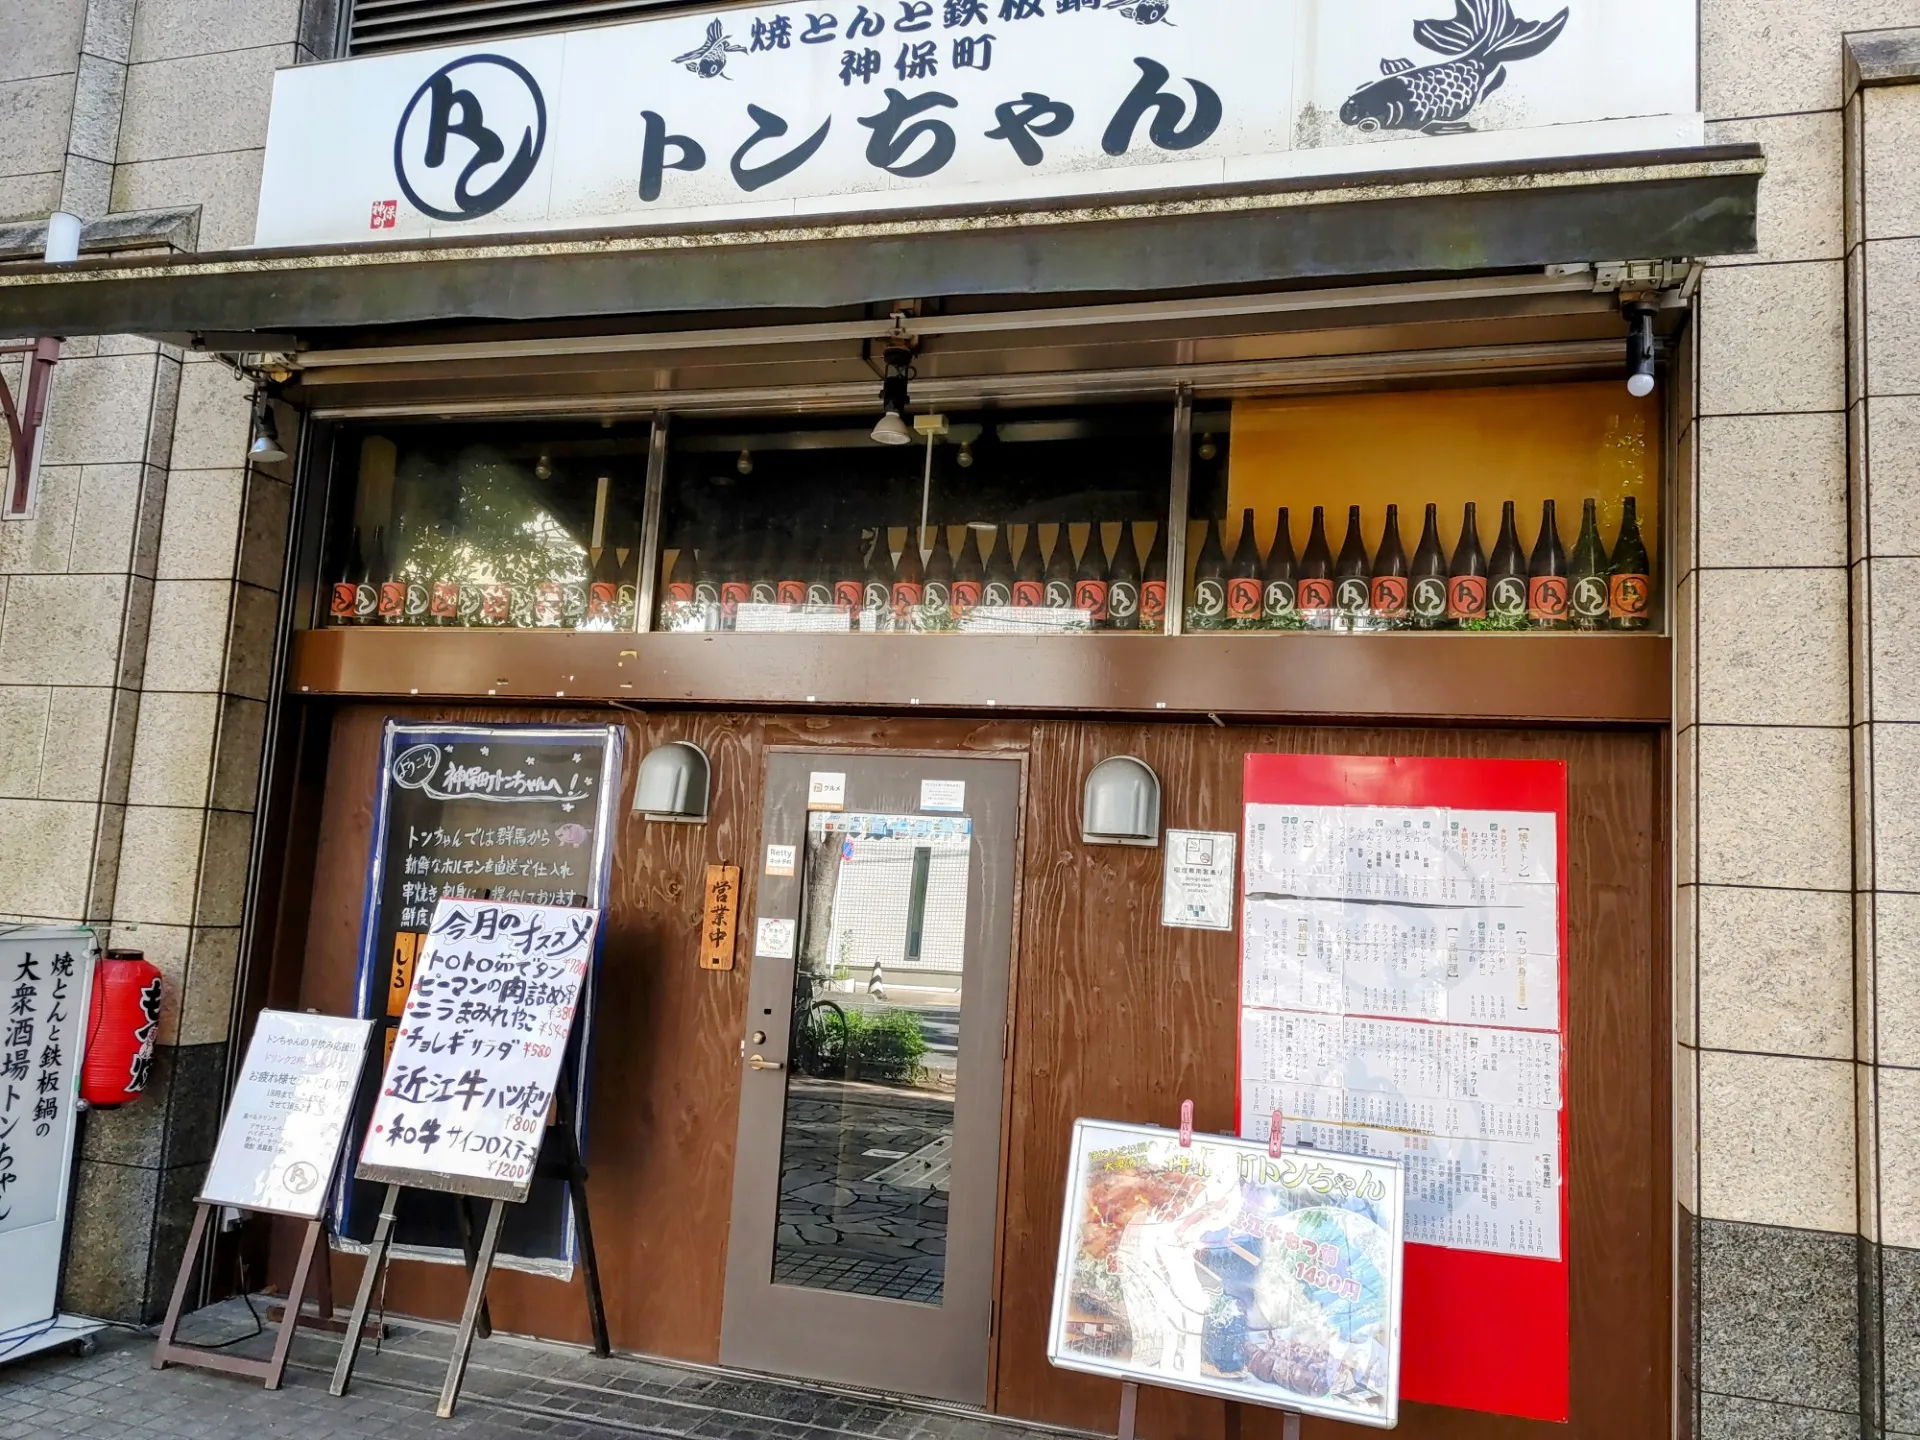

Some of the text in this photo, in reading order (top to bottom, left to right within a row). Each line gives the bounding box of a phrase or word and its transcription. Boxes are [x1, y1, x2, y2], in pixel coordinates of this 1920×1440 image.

[838, 34, 997, 86] 神保町
[638, 56, 1225, 203] トンちゃん
[408, 824, 550, 849] トンちゃんでは群馬から
[404, 854, 575, 878] 新鮮なホルモンを直送で仕入れ
[770, 849, 793, 858] Retty
[400, 907, 434, 927] 鮮度
[709, 881, 732, 949] 営業中
[432, 908, 593, 956] 今月のオススメ
[32, 952, 74, 1138] 焼とんと鉄板鍋の
[523, 1042, 552, 1058] ¥580
[503, 1114, 537, 1134] ¥800
[486, 1159, 524, 1178] ¥1200
[1296, 1262, 1361, 1303] 1430円
